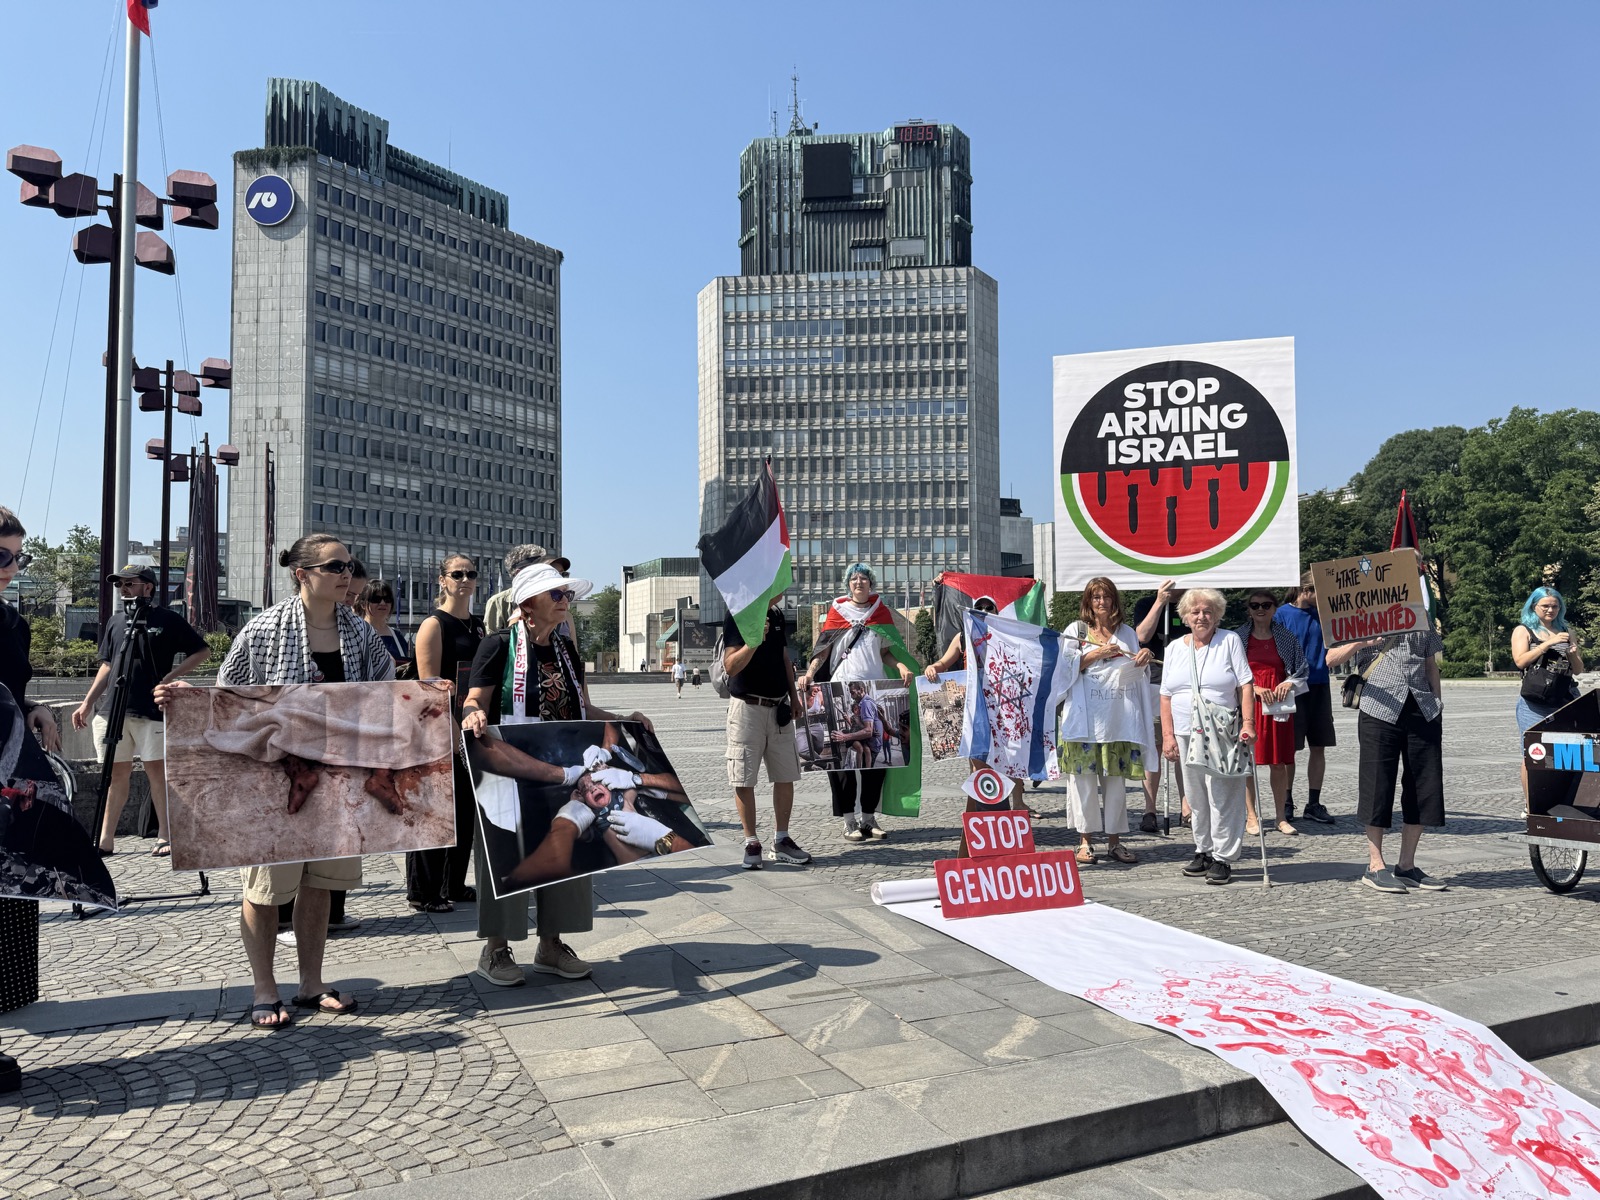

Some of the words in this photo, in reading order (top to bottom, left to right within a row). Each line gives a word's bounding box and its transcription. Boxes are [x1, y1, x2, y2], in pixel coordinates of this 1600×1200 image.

[1123, 377, 1220, 409] STOP
[1097, 403, 1248, 438] ARMING
[1107, 432, 1239, 465] ISRAEL
[1325, 568, 1335, 576] THE
[1335, 567, 1361, 589] STATE
[1375, 563, 1393, 582] OF
[1328, 593, 1353, 613] WAR
[1355, 583, 1409, 609] CRIMINALS
[1331, 603, 1417, 641] UNWANTED
[969, 816, 1029, 850] STOP
[944, 862, 1075, 905] GENOCIDU
